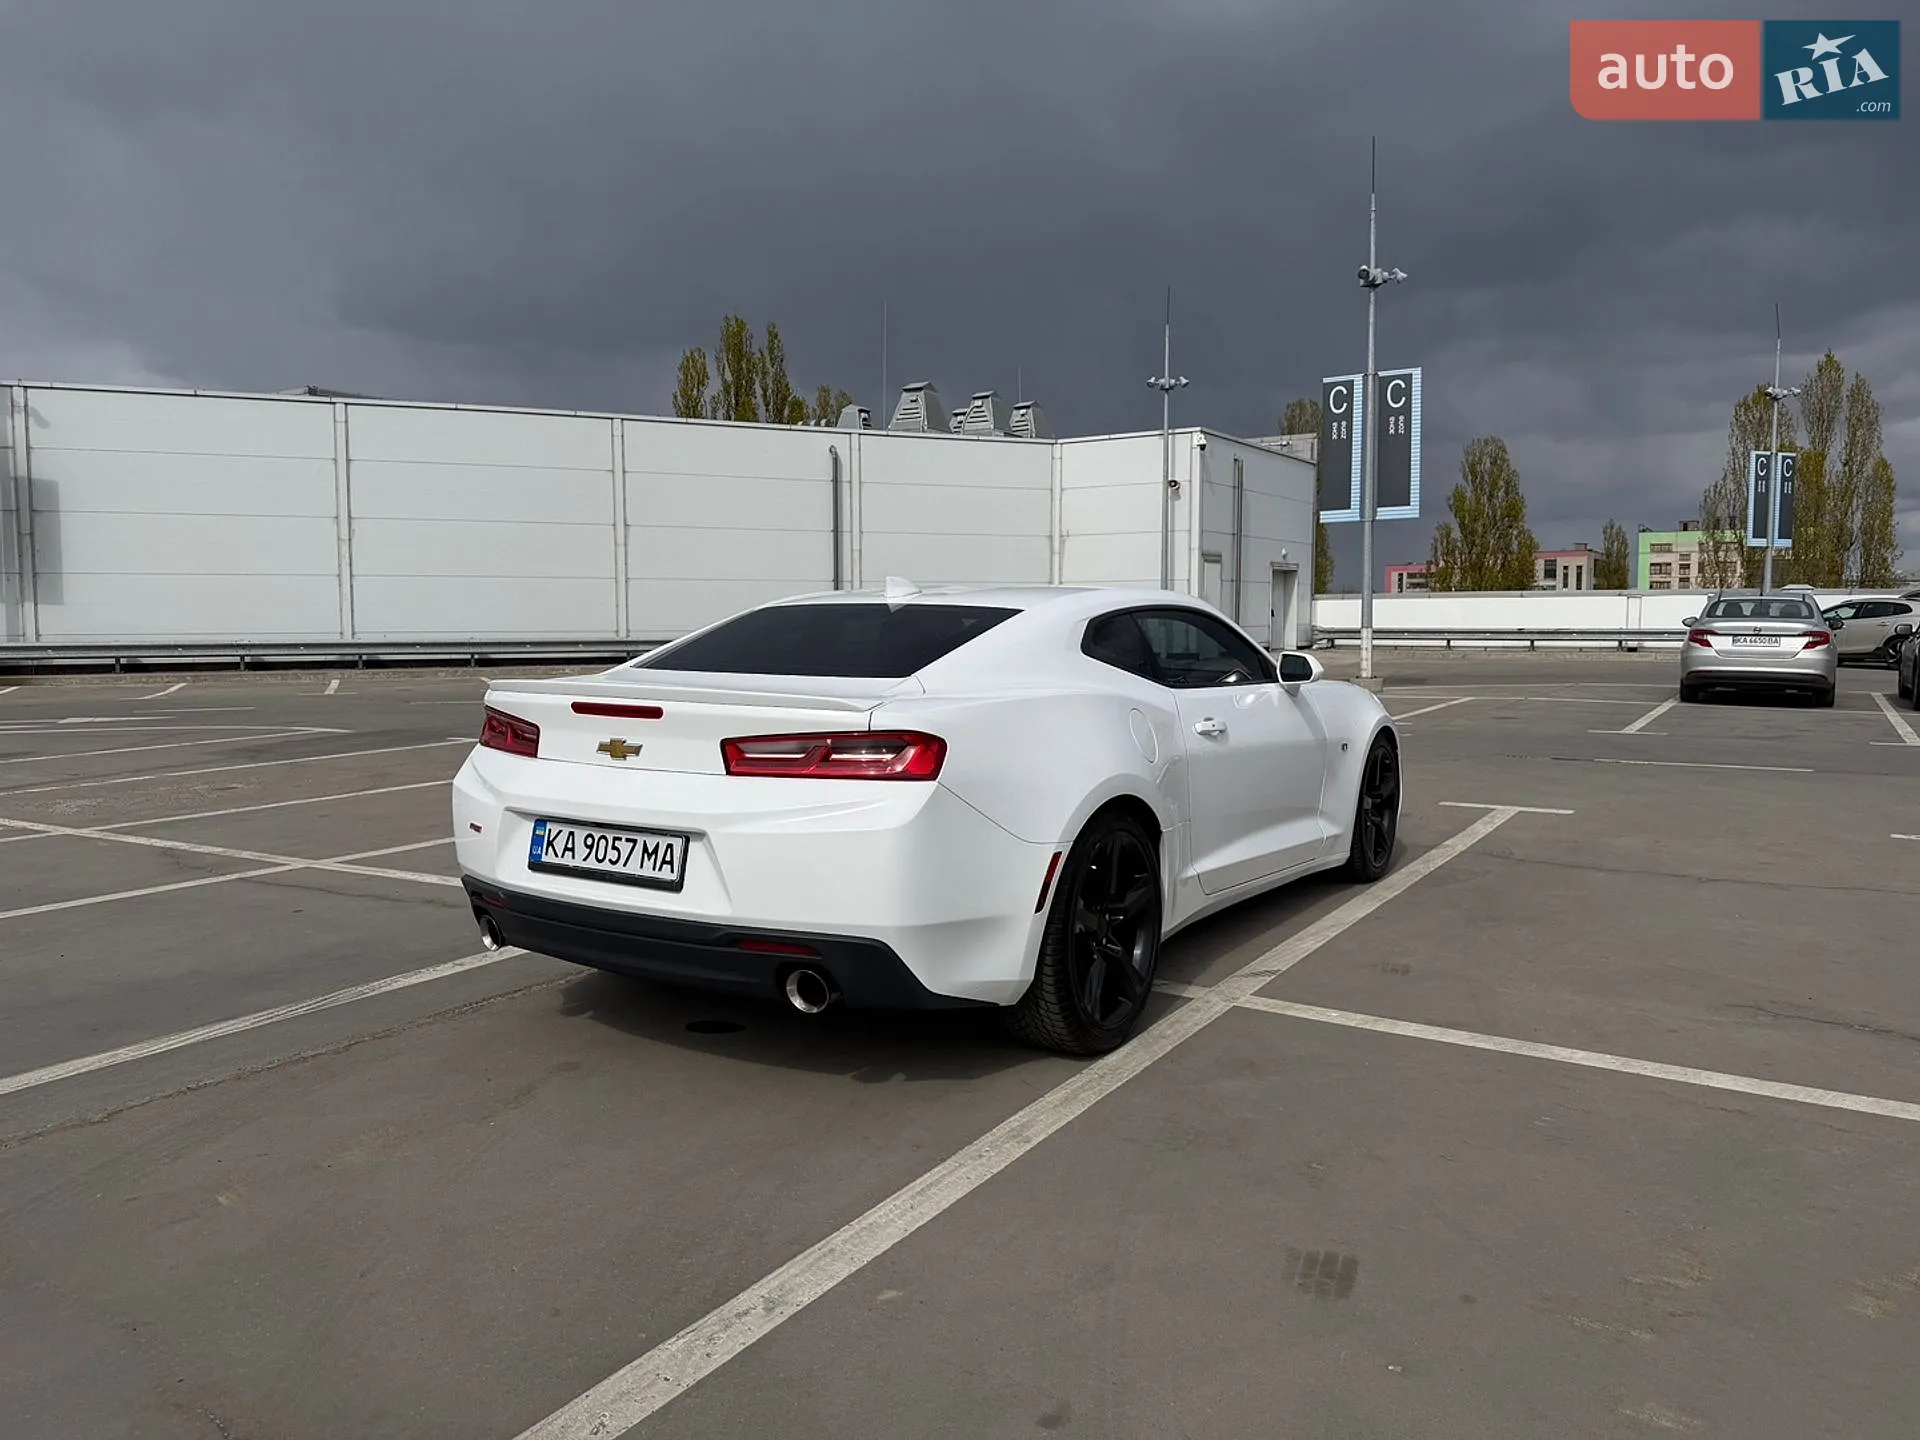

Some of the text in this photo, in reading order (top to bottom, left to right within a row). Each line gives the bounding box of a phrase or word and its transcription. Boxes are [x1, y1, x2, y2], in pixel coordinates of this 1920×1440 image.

[1329, 386, 1348, 414] C
[1387, 379, 1406, 408] C
[1757, 457, 1767, 476] C
[1783, 458, 1793, 477] C
[532, 845, 541, 855] UA
[545, 828, 675, 874] KA 9057 MA
